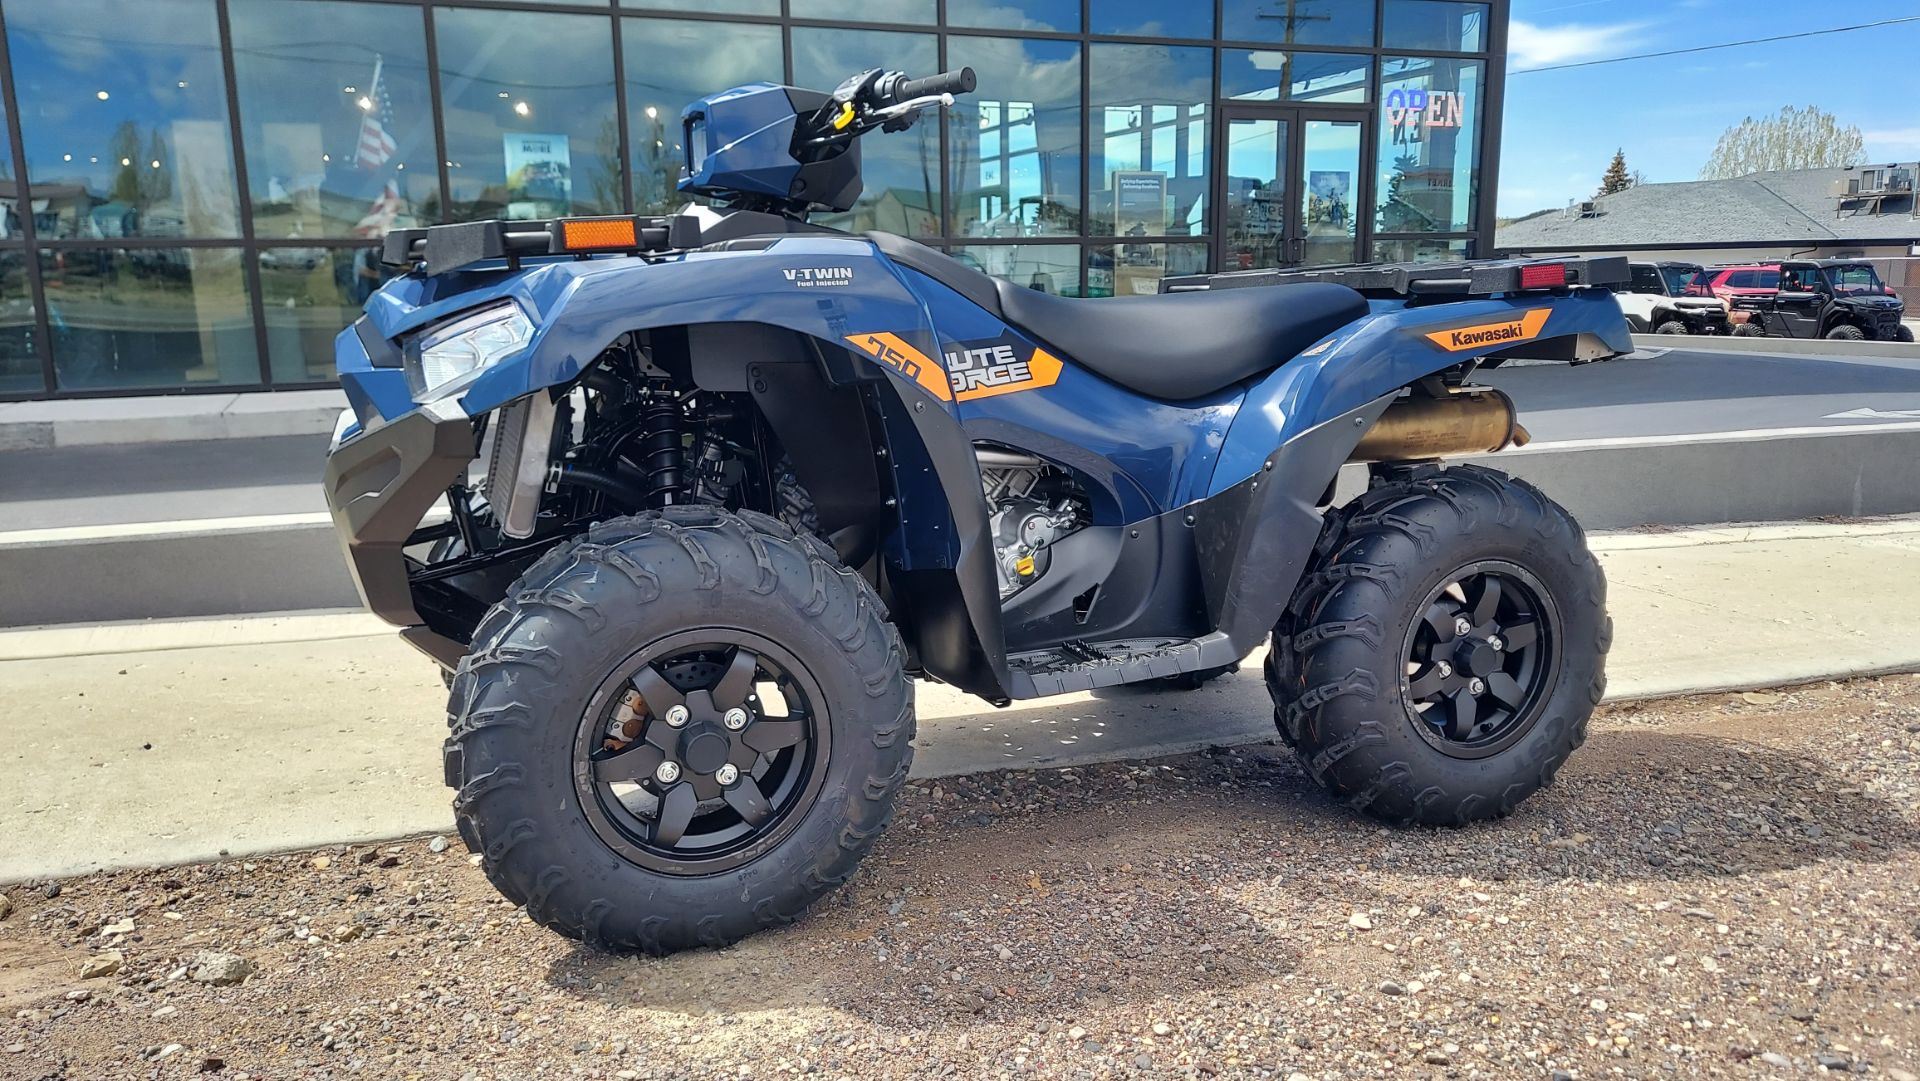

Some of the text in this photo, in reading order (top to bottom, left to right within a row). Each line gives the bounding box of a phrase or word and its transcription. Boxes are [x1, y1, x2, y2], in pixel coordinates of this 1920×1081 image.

[1387, 89, 1465, 127] OPEN
[783, 268, 853, 280] V-TWIN
[1451, 324, 1523, 346] Kawasaki
[867, 336, 922, 382] 750
[945, 345, 1017, 368] UTE
[951, 361, 1033, 392] ORCE
